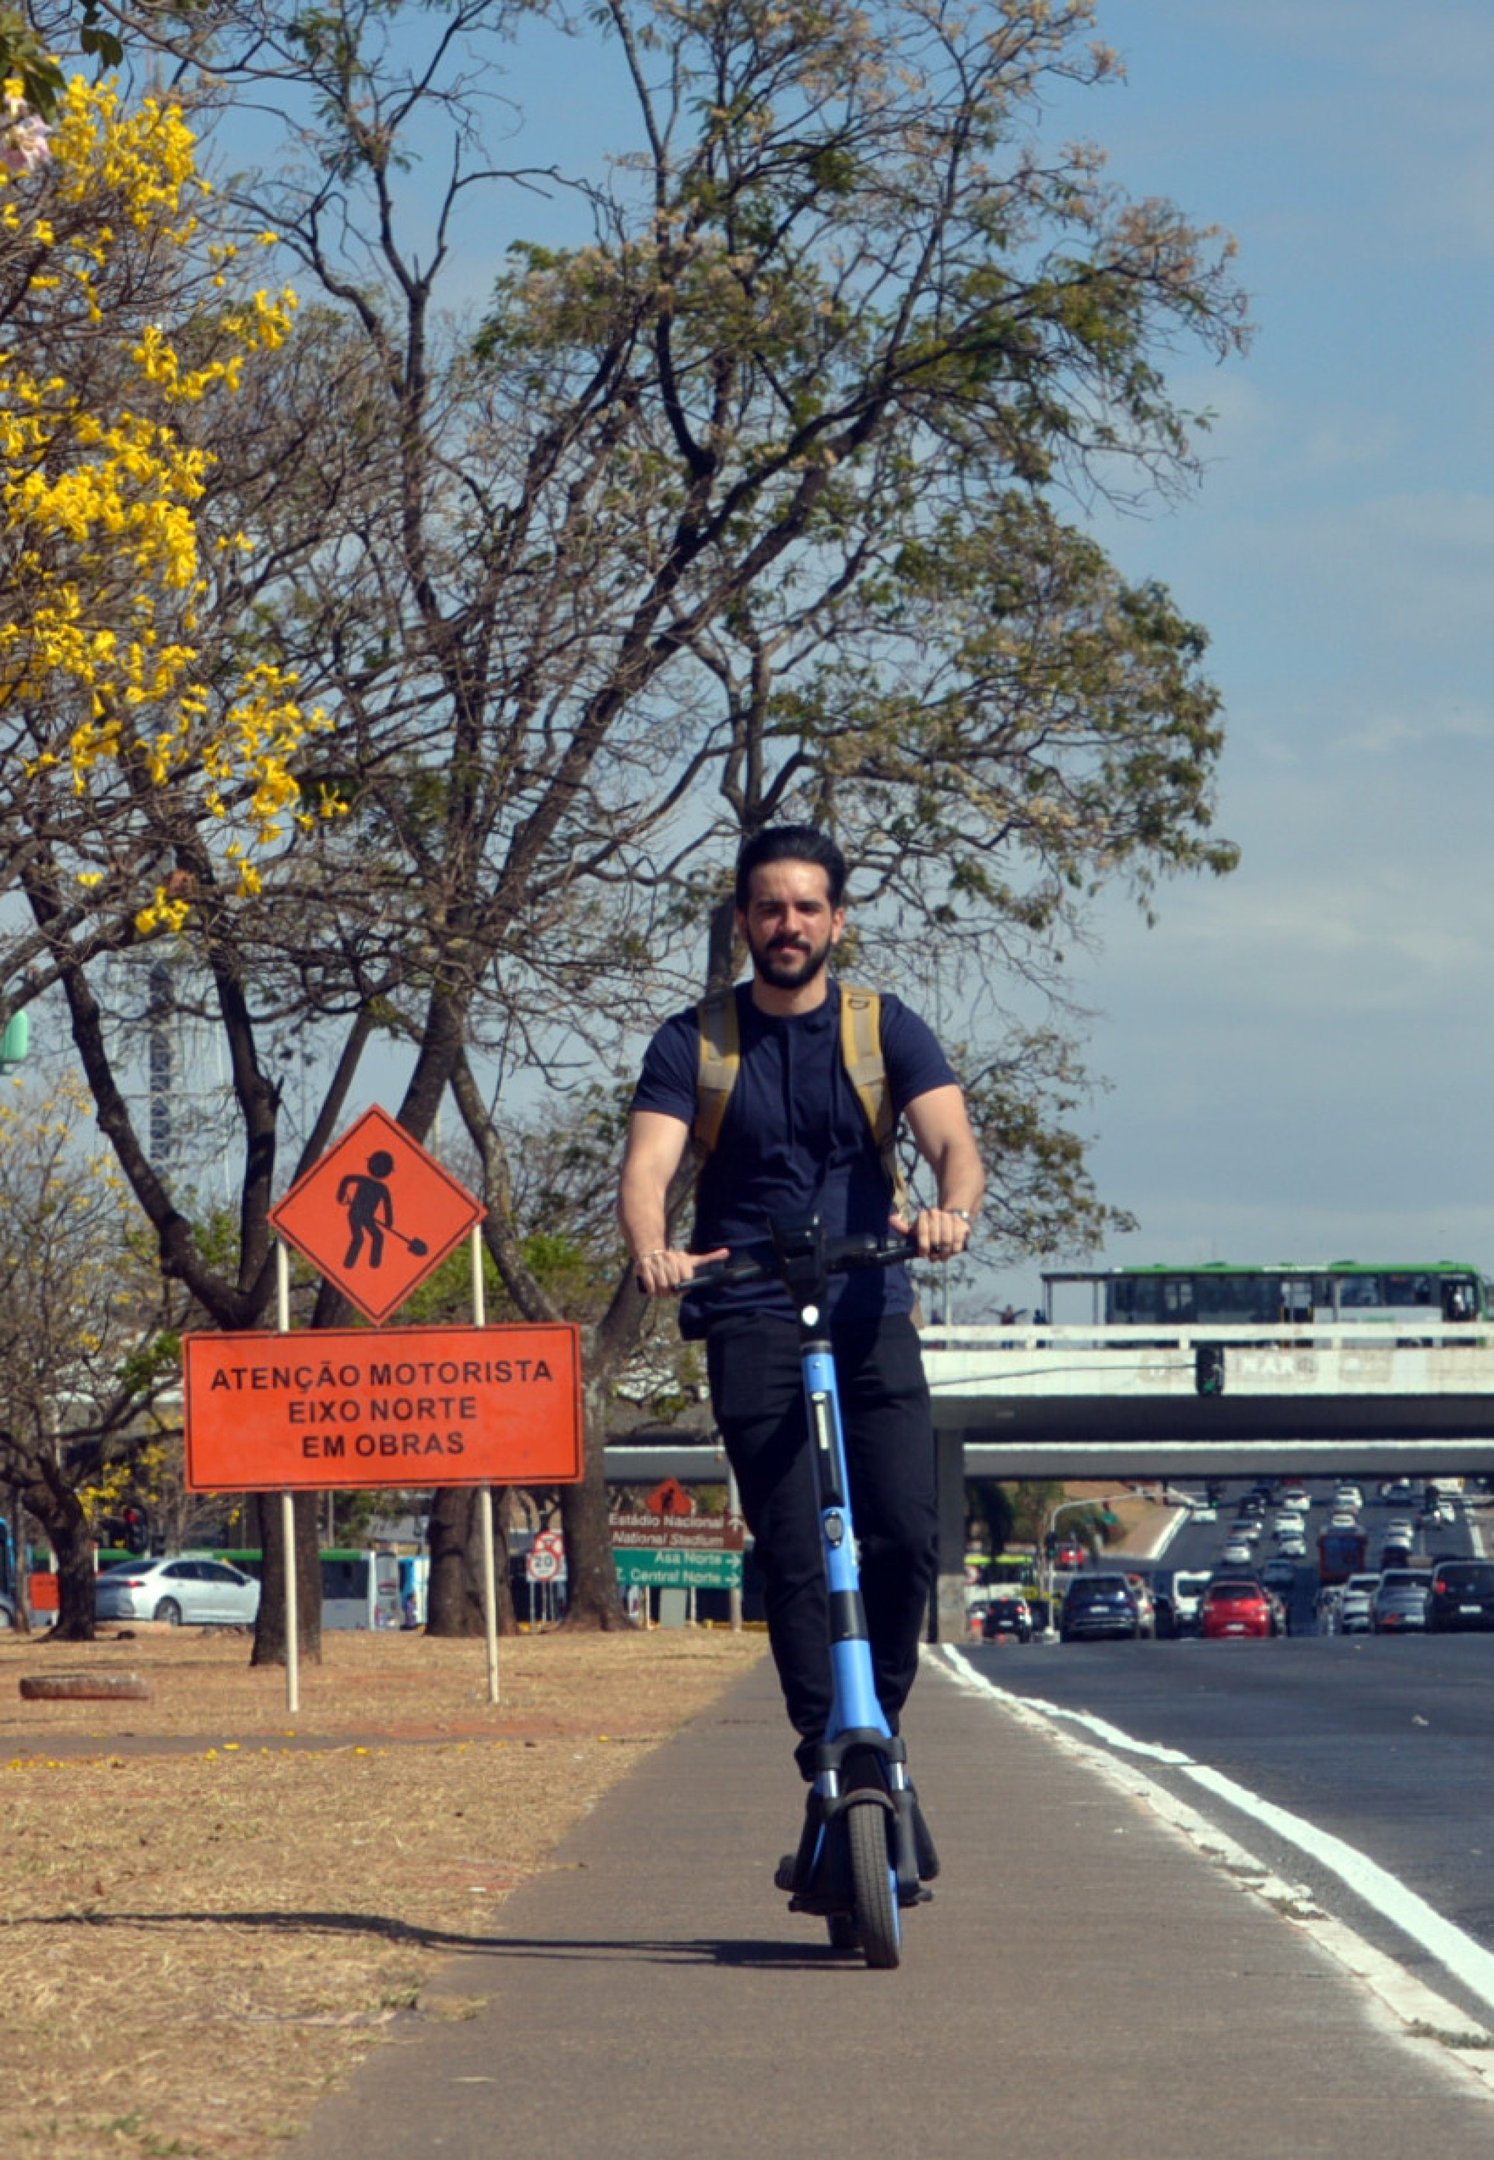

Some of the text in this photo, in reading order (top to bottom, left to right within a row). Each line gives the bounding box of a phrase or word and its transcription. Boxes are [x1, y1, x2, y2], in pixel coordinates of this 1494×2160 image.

[210, 1360, 553, 1392] ATENÇÃO MOTORISTA
[289, 1396, 478, 1424] EIXO NORTE
[302, 1432, 465, 1458] EM OBRAS
[608, 1513, 725, 1528] Estádio Nacional
[612, 1530, 724, 1547] National Stadium
[654, 1552, 722, 1566] Asa Norte
[630, 1567, 680, 1582] Central
[683, 1569, 722, 1584] Norte
